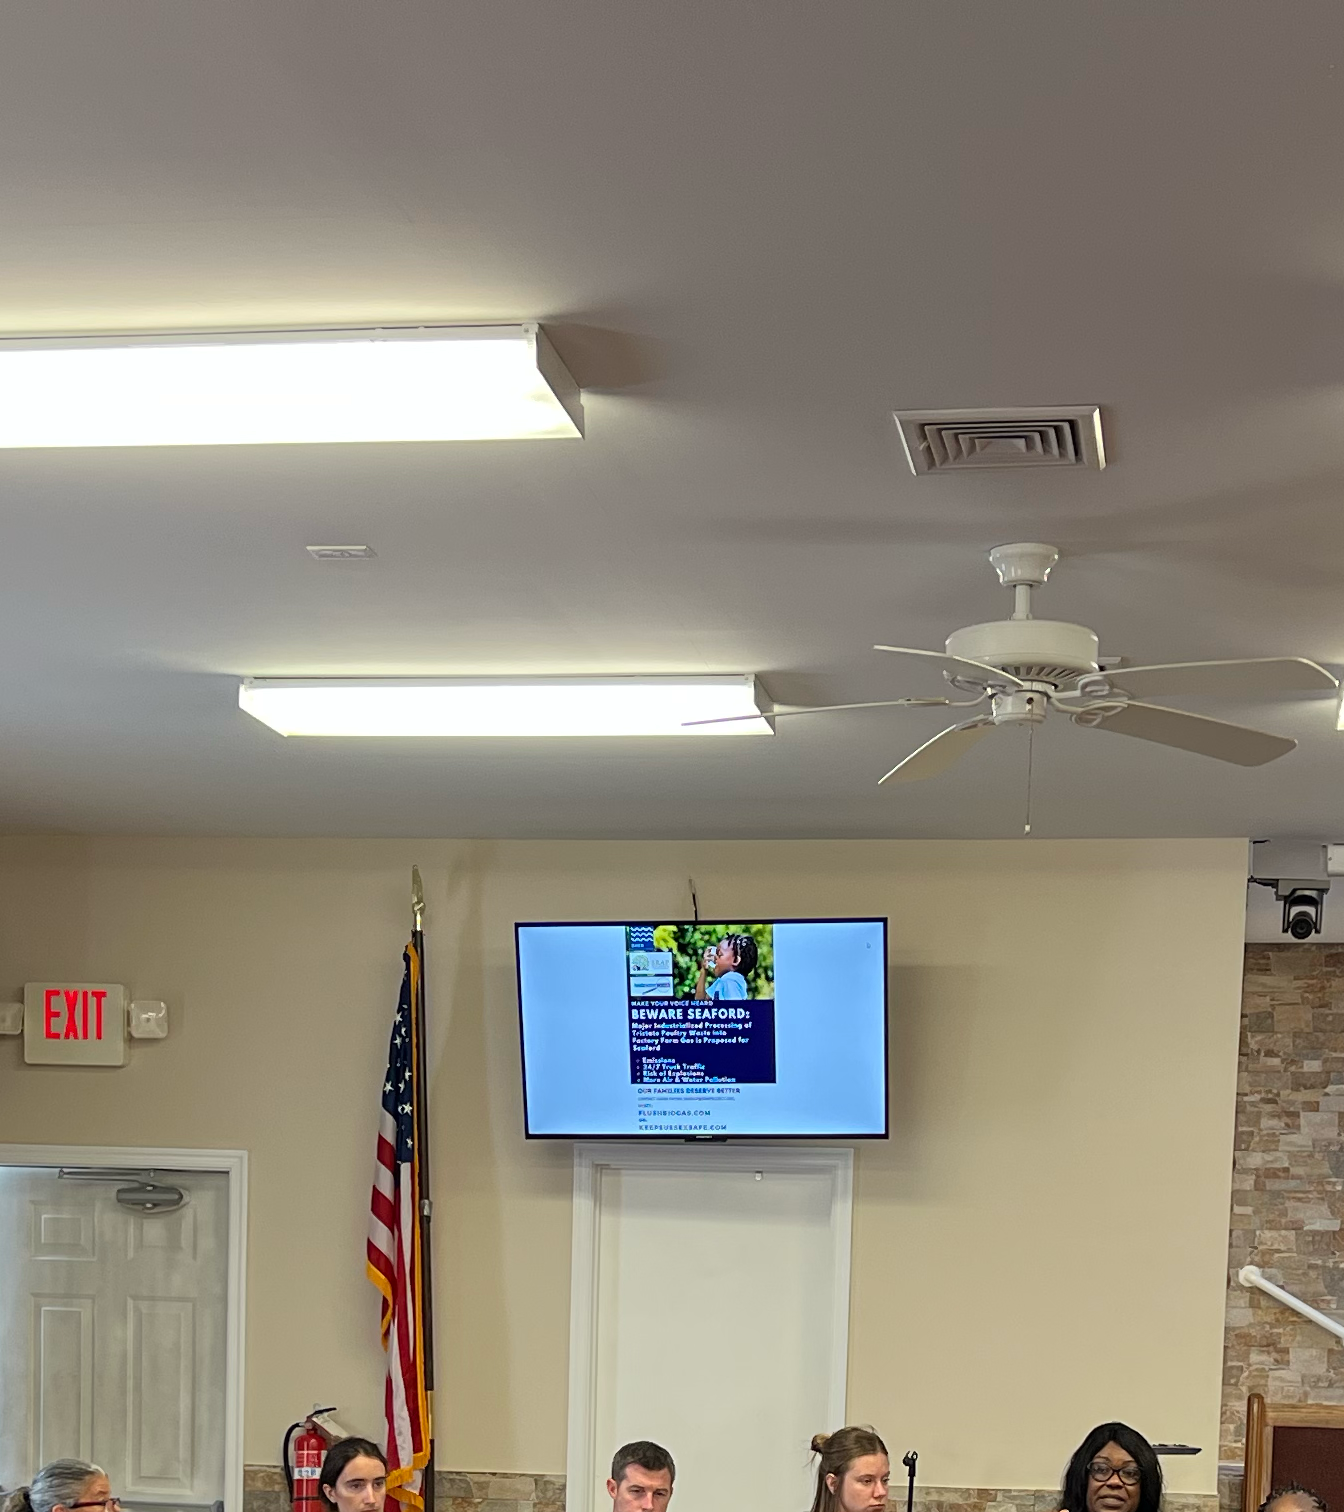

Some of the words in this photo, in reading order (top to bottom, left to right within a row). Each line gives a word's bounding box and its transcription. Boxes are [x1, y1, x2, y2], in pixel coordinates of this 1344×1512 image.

[44, 989, 107, 1040] EXIT
[632, 1009, 683, 1019] BEWARE
[687, 1008, 750, 1019] SEAFORD:
[632, 1022, 652, 1030] Major
[705, 1022, 742, 1030] Processing
[632, 1037, 659, 1045] Factory
